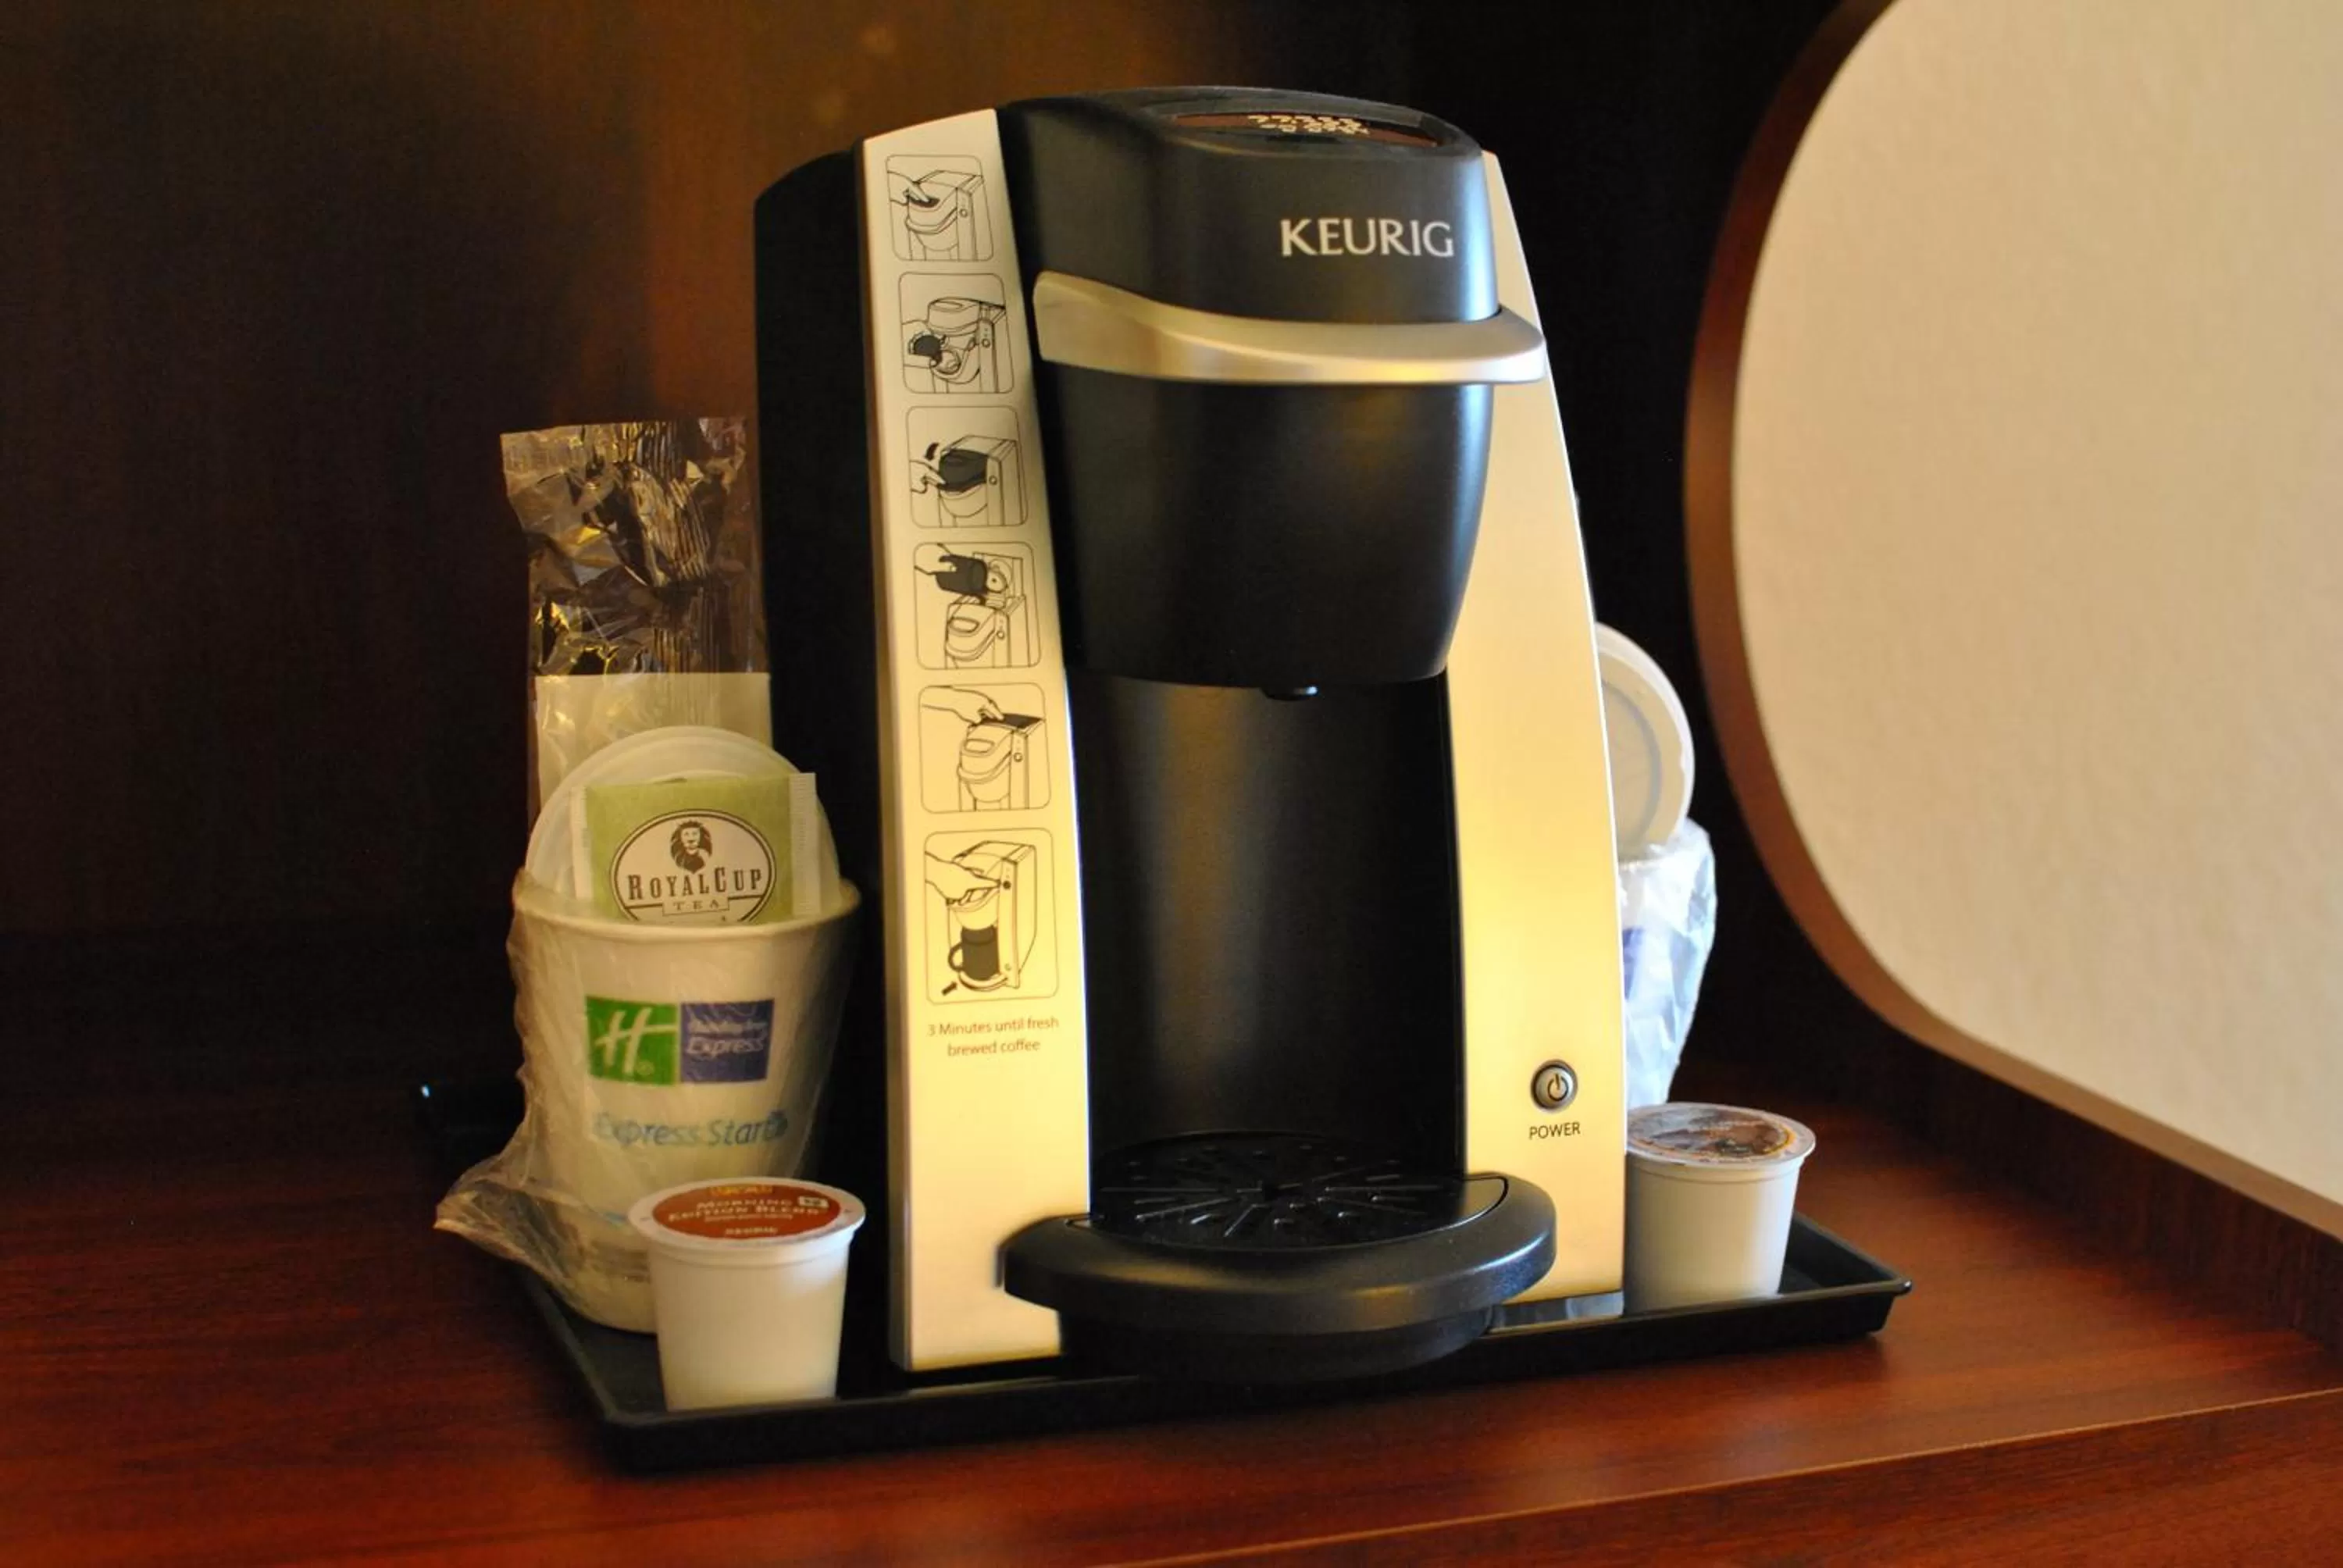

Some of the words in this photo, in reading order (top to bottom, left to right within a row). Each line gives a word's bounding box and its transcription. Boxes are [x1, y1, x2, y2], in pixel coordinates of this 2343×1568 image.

[1279, 217, 1454, 258] KEURIG
[672, 898, 720, 911] TEA
[926, 1024, 936, 1037] 3
[939, 1023, 992, 1035] Minutes
[995, 1018, 1025, 1032] until
[1027, 1016, 1059, 1031] fresh
[947, 1040, 997, 1057] brewed
[1000, 1039, 1040, 1053] coffee
[1528, 1121, 1581, 1140] POWER
